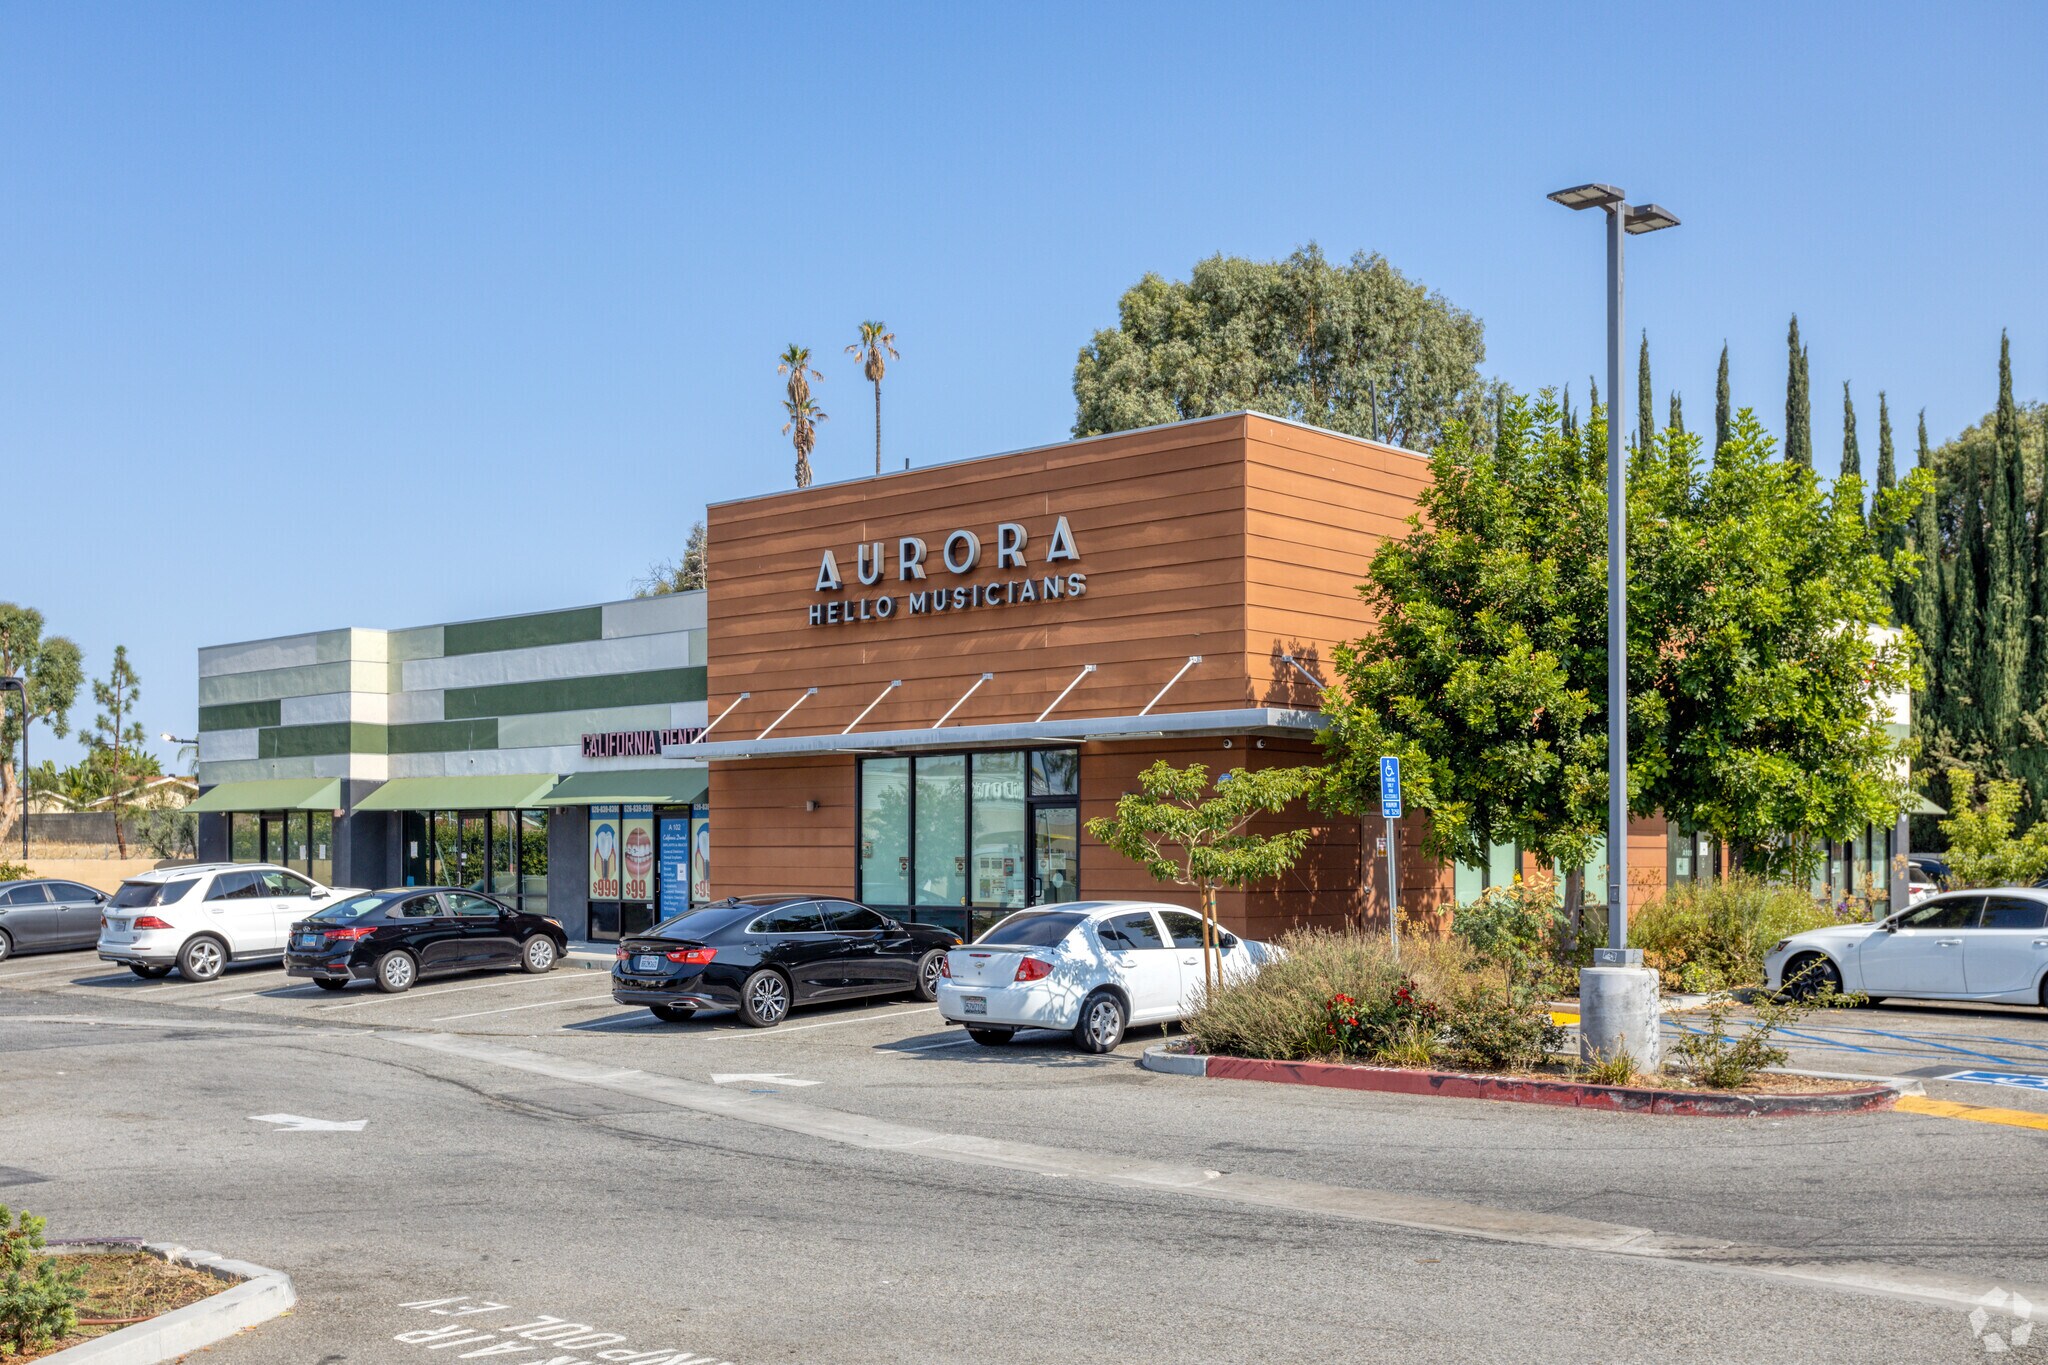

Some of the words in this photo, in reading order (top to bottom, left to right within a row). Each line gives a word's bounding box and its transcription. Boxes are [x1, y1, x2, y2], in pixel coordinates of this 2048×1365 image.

[815, 515, 1080, 592] AURORA
[809, 595, 897, 625] HELLO
[909, 573, 1087, 614] MUSICIANS
[581, 730, 657, 758] CALIFORNIA
[593, 879, 618, 897] $999
[626, 879, 646, 899] $99
[398, 1296, 513, 1317] EV
[394, 1325, 538, 1358] AIR
